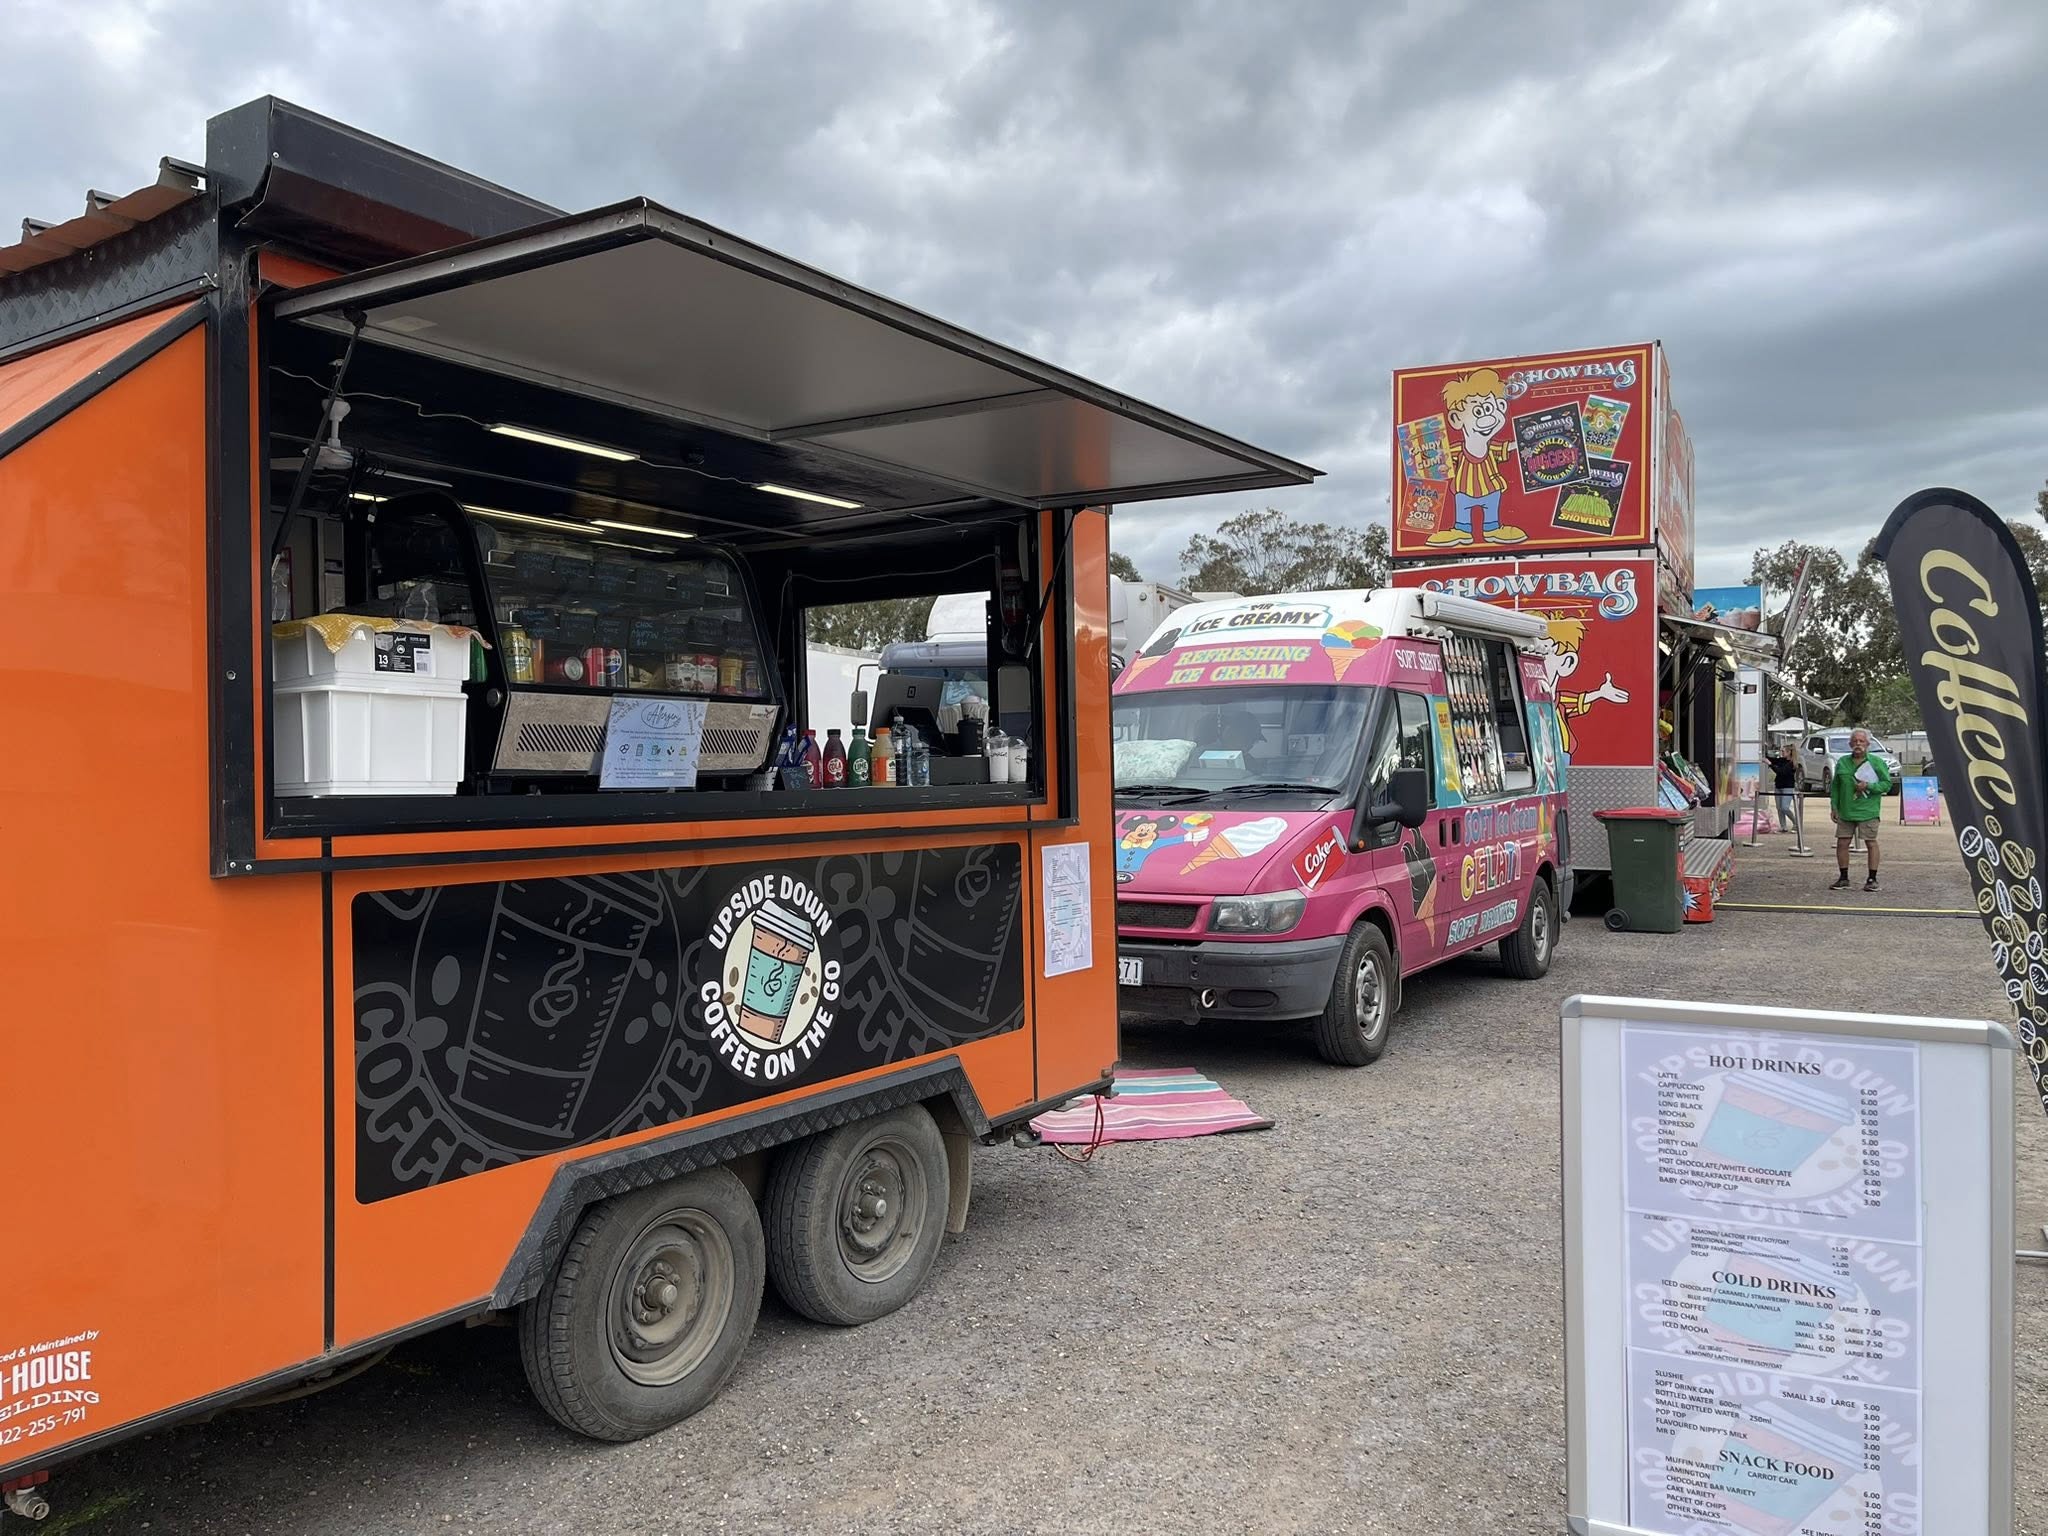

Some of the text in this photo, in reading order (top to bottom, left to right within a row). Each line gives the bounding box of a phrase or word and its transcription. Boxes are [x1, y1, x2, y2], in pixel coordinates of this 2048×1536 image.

[1504, 360, 1636, 399] SHOWBAG
[1532, 385, 1608, 395] FACTORY
[1536, 462, 1575, 480] SHOWBAG
[1413, 488, 1439, 498] MEGA
[1409, 511, 1435, 521] SOUR
[1191, 611, 1321, 632] ICE CREAMY
[378, 654, 388, 665] 13
[1174, 646, 1312, 666] REFRESHING
[1395, 649, 1442, 672] SOFT SERVE
[1165, 663, 1291, 685] ICE CREAM
[1920, 549, 2028, 811] Coffee
[1464, 805, 1493, 846] SOFT
[1305, 838, 1336, 873] Coke
[1461, 840, 1521, 901] GELATI
[708, 875, 832, 950] UPSIDE DOWN
[1447, 899, 1518, 946] SOFT DRINKS
[701, 981, 761, 1078] COFFEE
[764, 1049, 795, 1079] ON
[797, 1006, 833, 1059] THE
[823, 960, 840, 1001] GO
[1709, 1055, 1821, 1076] HOT DRINKS
[1658, 1082, 1705, 1091] CAPPUCCINO
[1658, 1091, 1674, 1099] FLAT
[1658, 1100, 1678, 1108] LONG
[1681, 1102, 1703, 1110] BLACK
[1659, 1110, 1687, 1118] MOCHA
[1659, 1119, 1695, 1128] EXPRESSO
[1658, 1138, 1678, 1146] DIRTY
[1681, 1140, 1698, 1148] CHAI
[1659, 1157, 1673, 1165] HOT
[1676, 1158, 1746, 1173] CHOCOLATE/WHITE
[1748, 1166, 1792, 1177] CHOCOLATE
[1659, 1167, 1689, 1176] ENGLISH
[1691, 1170, 1752, 1183] BREAKFAST/EARL
[1755, 1177, 1774, 1185] GREY
[1659, 1176, 1677, 1184] BABY
[1680, 1179, 1721, 1190] CHINO/PUP
[1712, 1270, 1836, 1299] COLD DRINKS
[1662, 1299, 1882, 1337] ICED COFFEE SMALL 5.50 LARGE 7.50
[1662, 1310, 1678, 1318] ICED
[1680, 1313, 1698, 1321] CHAI
[1794, 1331, 1814, 1339] SMALL
[1818, 1334, 1835, 1342] 5.50
[1866, 1340, 1883, 1348] 7.50
[18, 1347, 26, 1357] &
[29, 1331, 85, 1355] Maintained
[87, 1330, 100, 1341] by
[1662, 1321, 1883, 1360] ICED MOCHA SMALL 6.00 LARGE 8.00
[1655, 1370, 1880, 1412] SLUSHIE SMALL 3.50 LARGE 5.00
[1655, 1379, 1880, 1422] SOFT DRINK CAN 3.00
[1655, 1389, 1880, 1431] BOTTLED WATER 600ml 3.00
[1655, 1399, 1880, 1441] SMALL BOTTLED WATER 250ml 2.00
[1656, 1408, 1880, 1451] POP TOP 3.00
[1656, 1418, 1880, 1461] FLAVOURED NIPPY'S MILK 3.00
[1656, 1427, 1668, 1435] MR
[1864, 1463, 1880, 1471] 5.00
[1666, 1456, 1880, 1500] MUFFIN VARIETY CARROT CAKE 6.00
[1719, 1450, 1835, 1480] SNACK FOOD
[1666, 1465, 1881, 1510] LAMINGTON 3.00
[1667, 1475, 1881, 1520] CHOCOLATE BAR VARIETY 3.00
[1667, 1494, 1694, 1505] PACKET
[1706, 1500, 1726, 1511] CHIPS
[1667, 1484, 1881, 1530] CAKE VARIETY 4.00
[1667, 1503, 1691, 1513] OTHER
[1693, 1508, 1720, 1519] SNACKS
